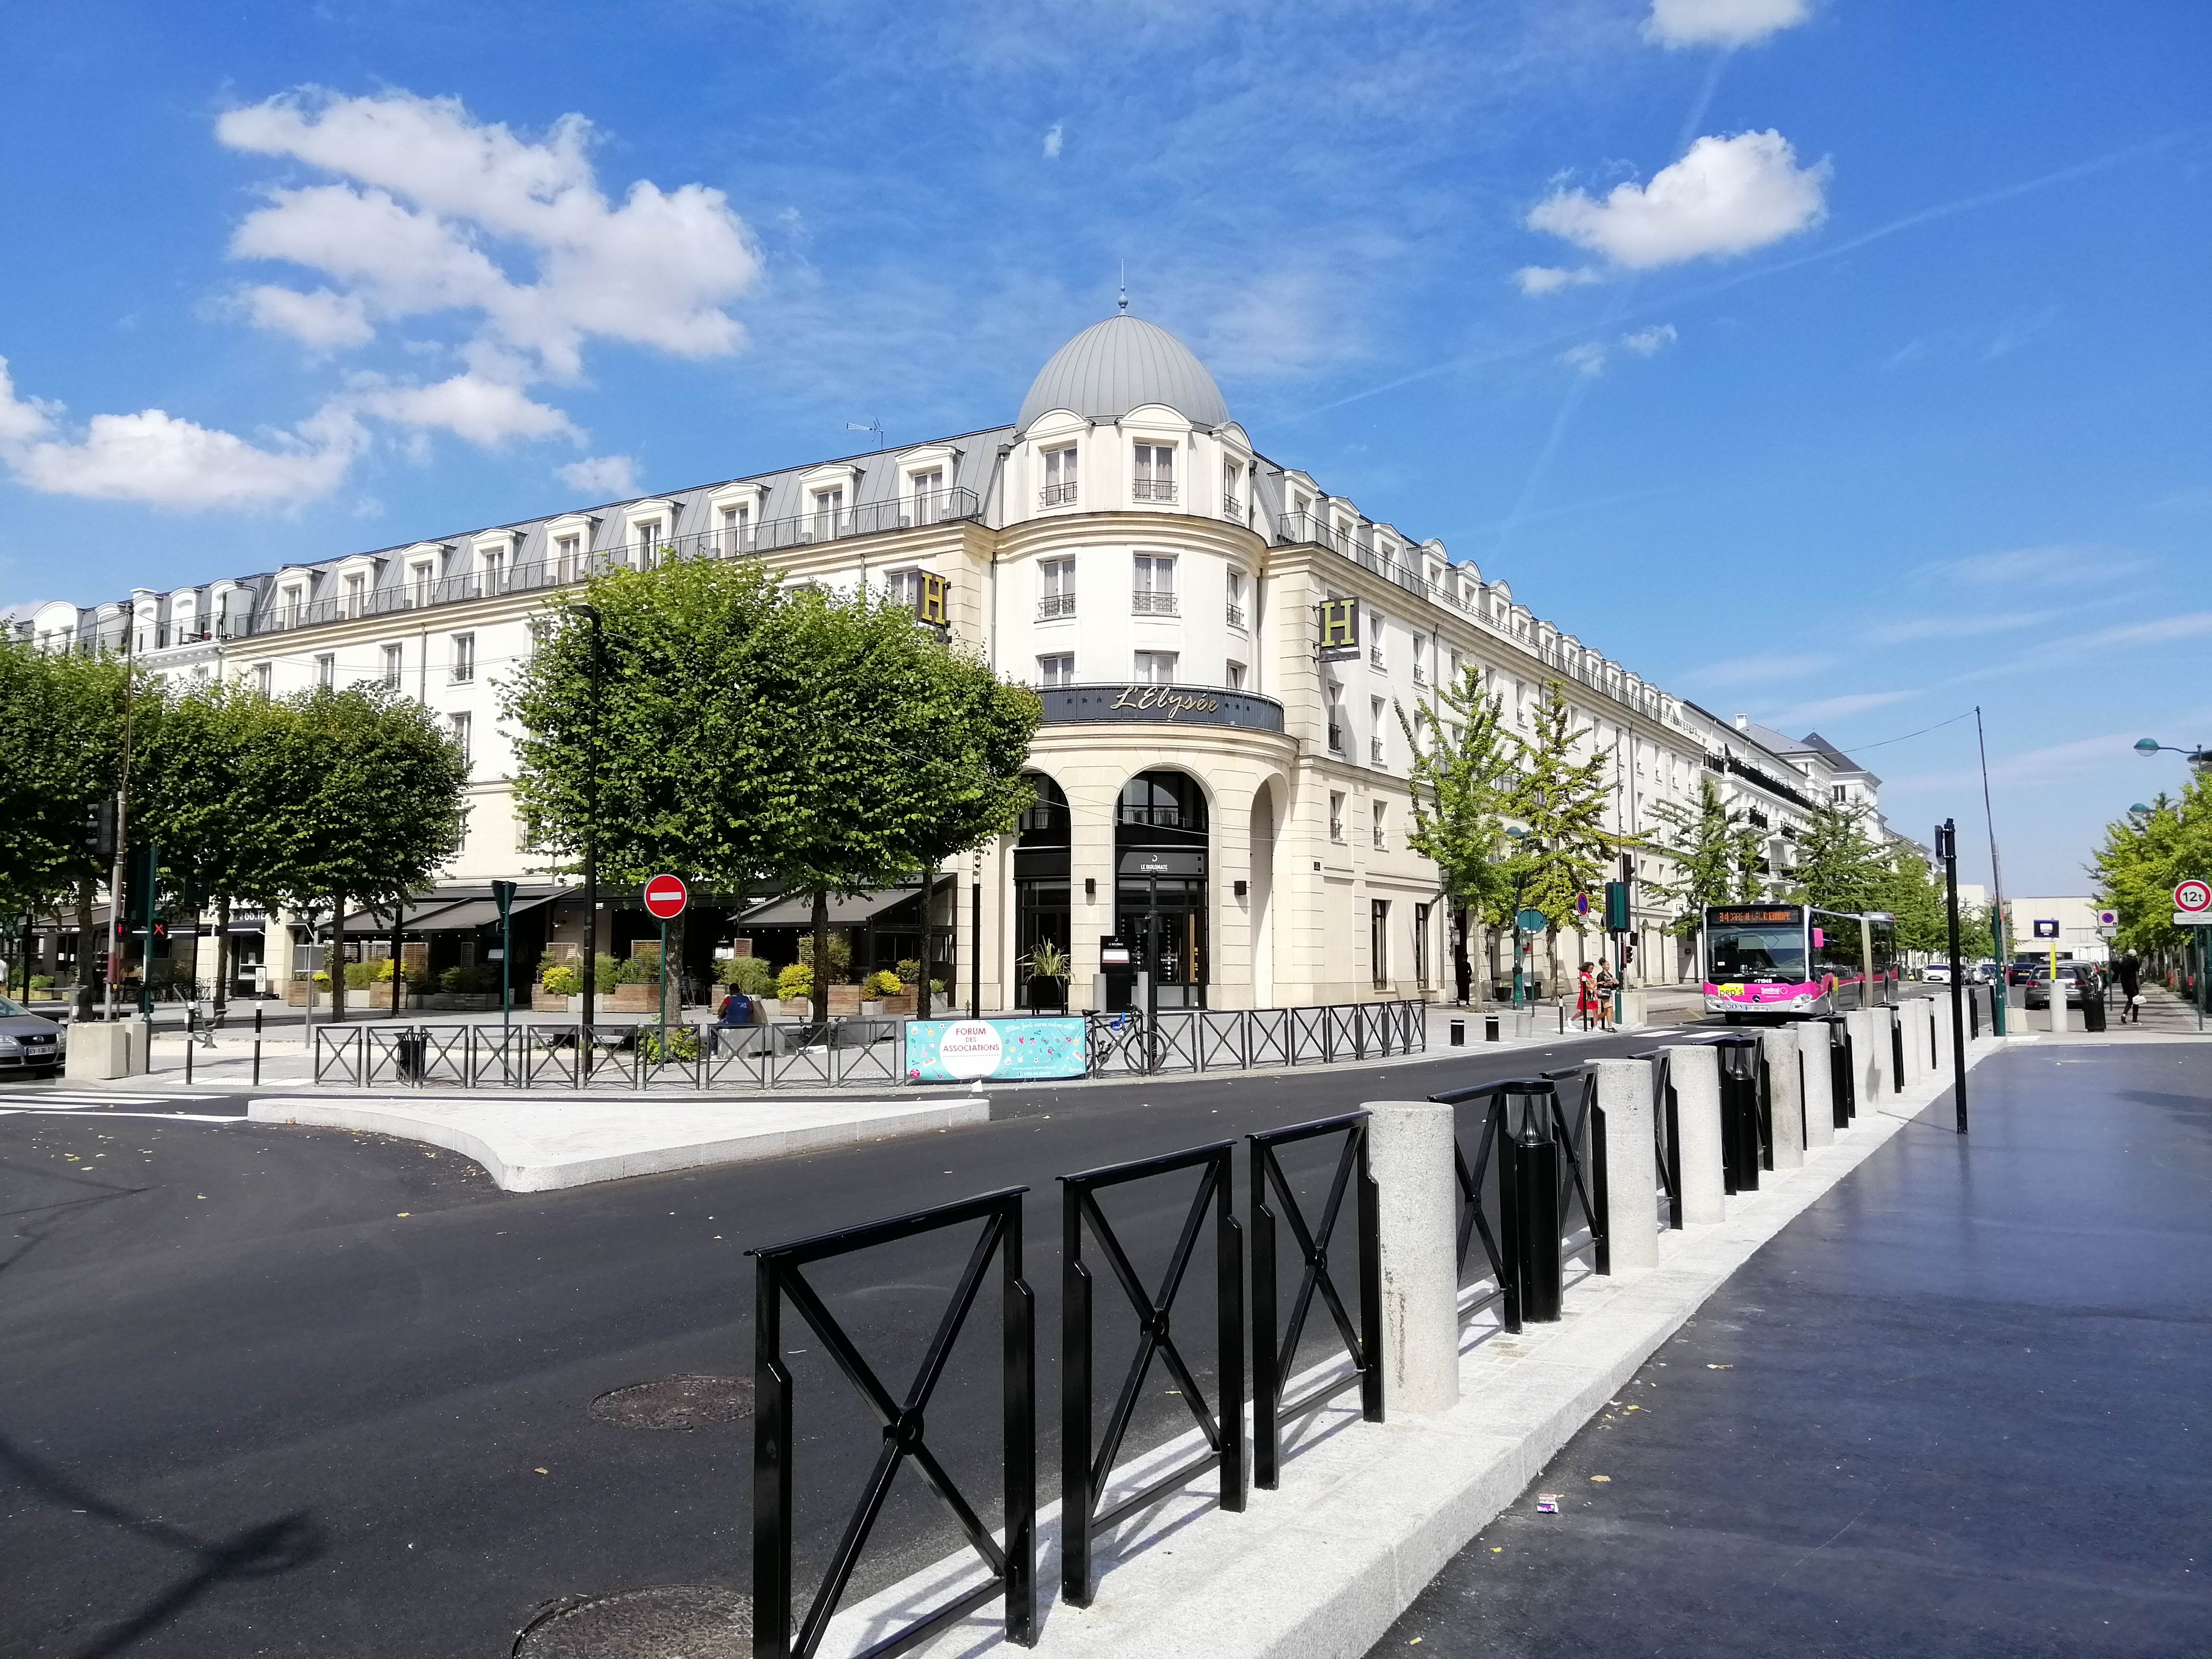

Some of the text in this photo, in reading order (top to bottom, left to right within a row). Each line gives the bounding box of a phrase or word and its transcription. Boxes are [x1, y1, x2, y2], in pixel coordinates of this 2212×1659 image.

[922, 572, 945, 625] H
[1322, 599, 1354, 647] H
[2183, 891, 2203, 902] 12t
[1719, 986, 1743, 997] pep's
